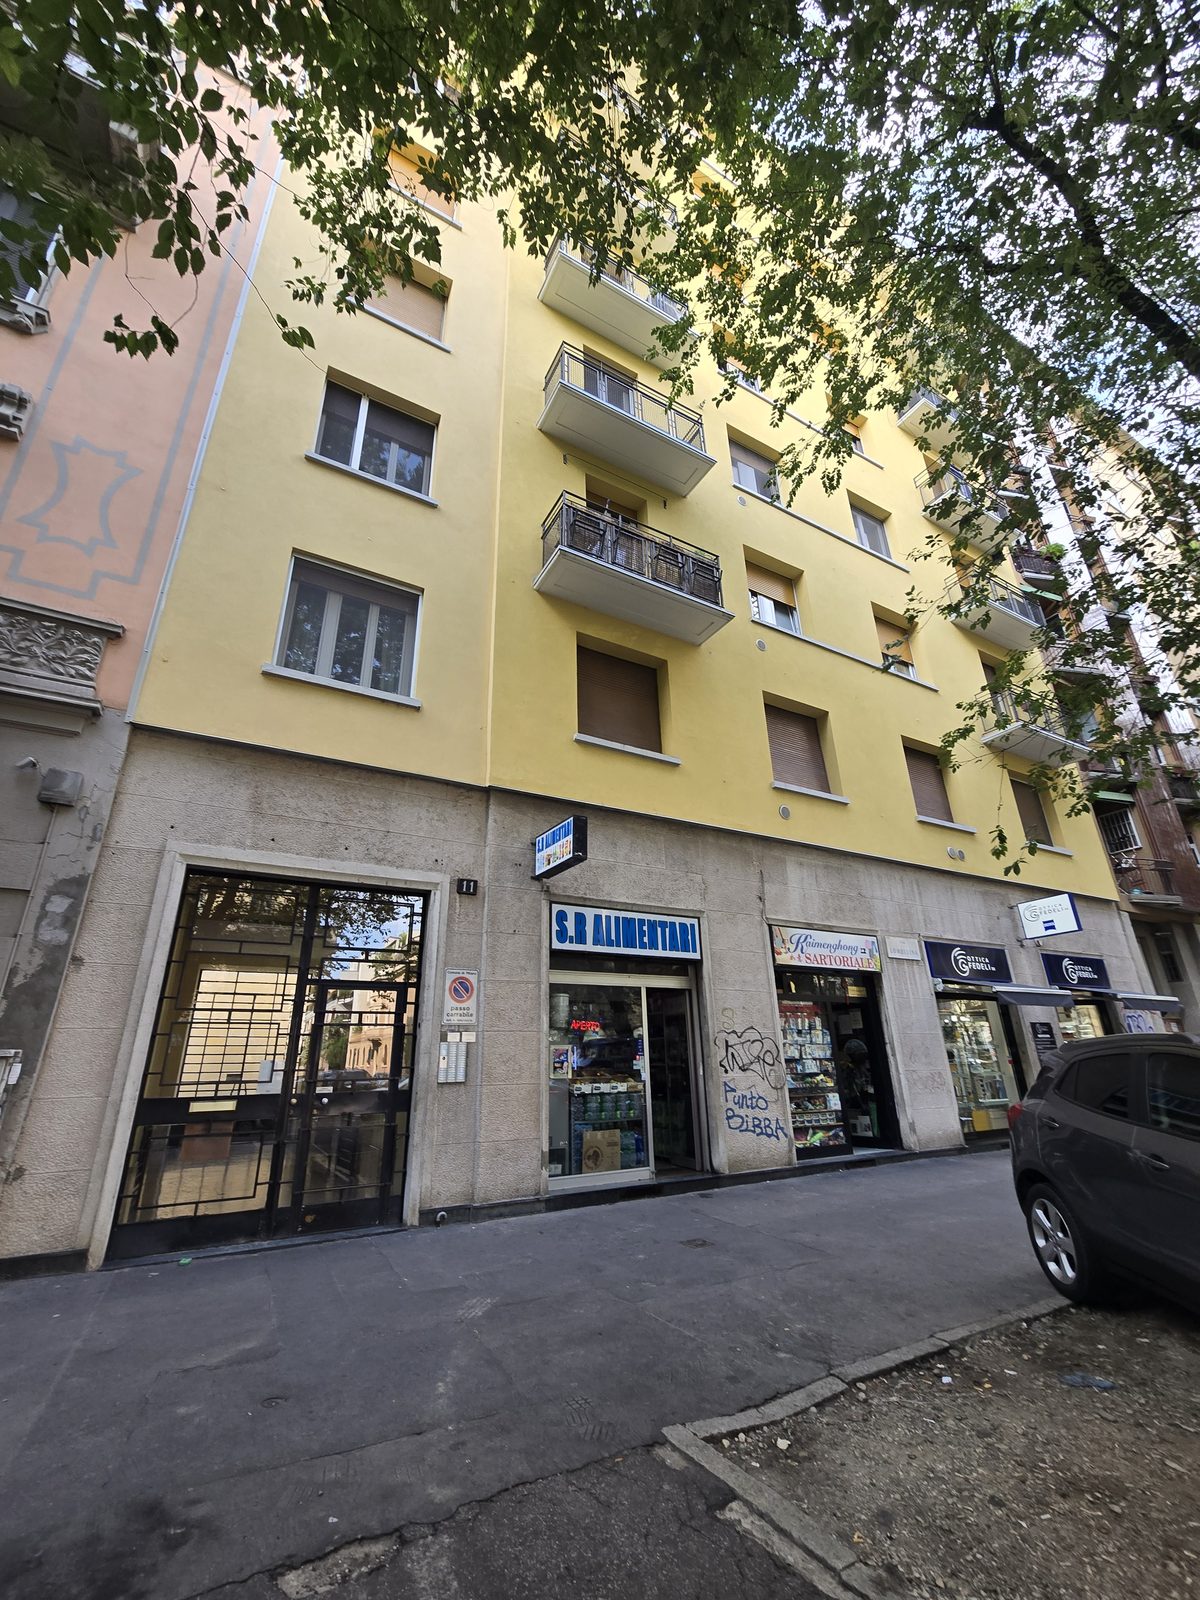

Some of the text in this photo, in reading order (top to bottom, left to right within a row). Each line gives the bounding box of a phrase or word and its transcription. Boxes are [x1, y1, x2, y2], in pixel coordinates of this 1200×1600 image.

[462, 881, 475, 893] 11
[555, 909, 698, 954] S.R ALIMENTARI
[787, 933, 859, 955] Kaimenghong
[804, 952, 875, 969] SARTORIALE
[966, 955, 990, 963] OTTICA
[967, 962, 991, 971] FEDELI
[570, 1019, 600, 1031] APERTO
